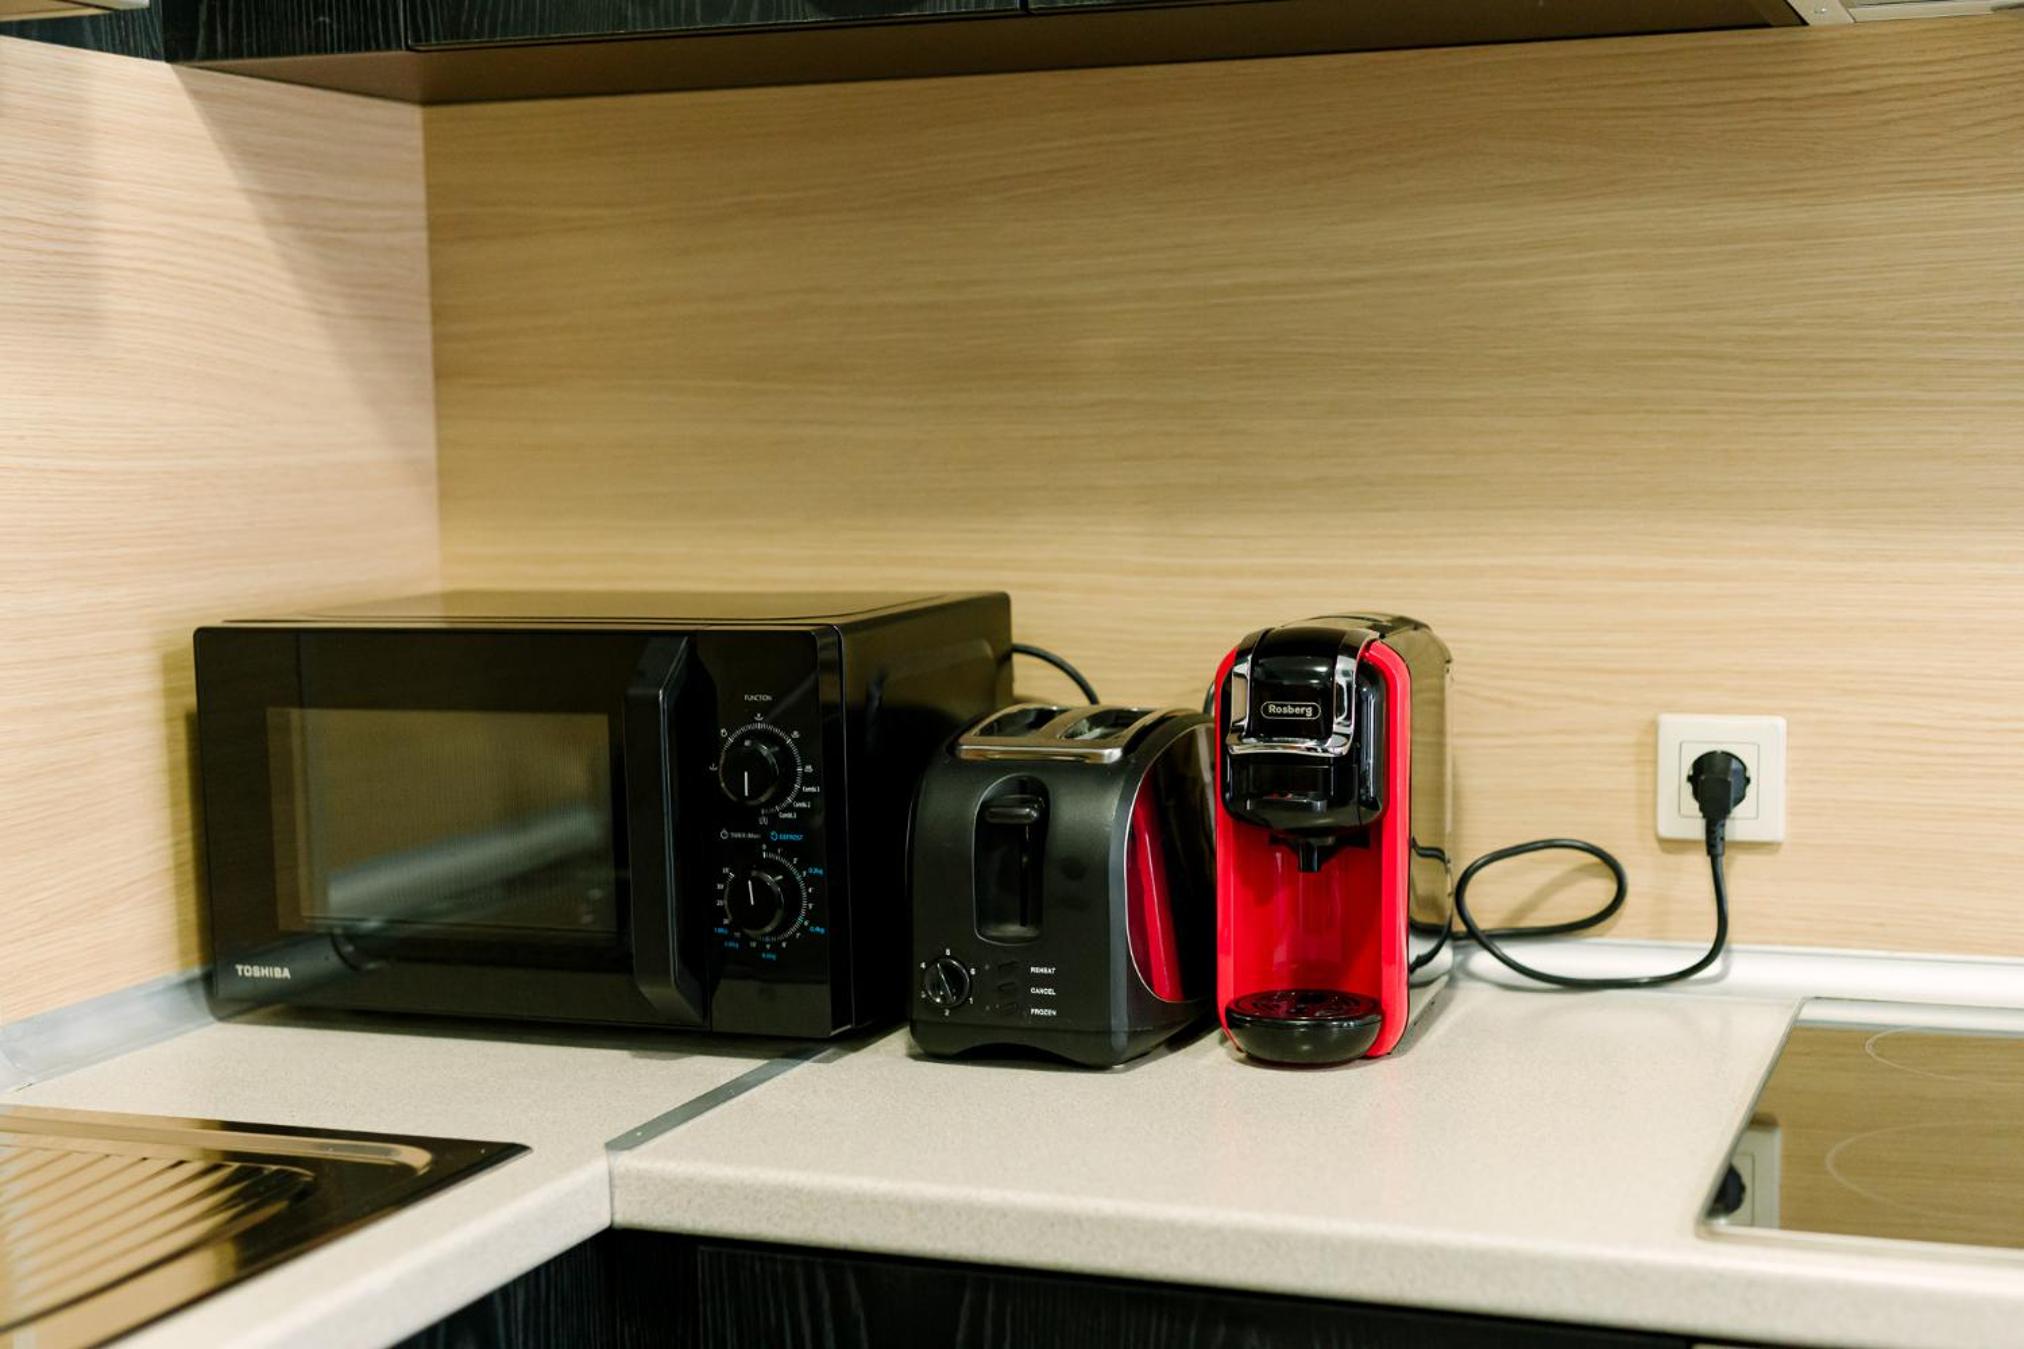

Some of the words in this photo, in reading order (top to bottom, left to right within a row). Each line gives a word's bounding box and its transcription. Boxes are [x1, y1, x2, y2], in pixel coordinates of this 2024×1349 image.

[1268, 703, 1313, 717] Rosberg
[235, 963, 291, 979] TOSHIBA
[1030, 966, 1056, 974] REHEAT
[1030, 987, 1056, 995] CANCEL
[1030, 1008, 1057, 1016] FROZEN
